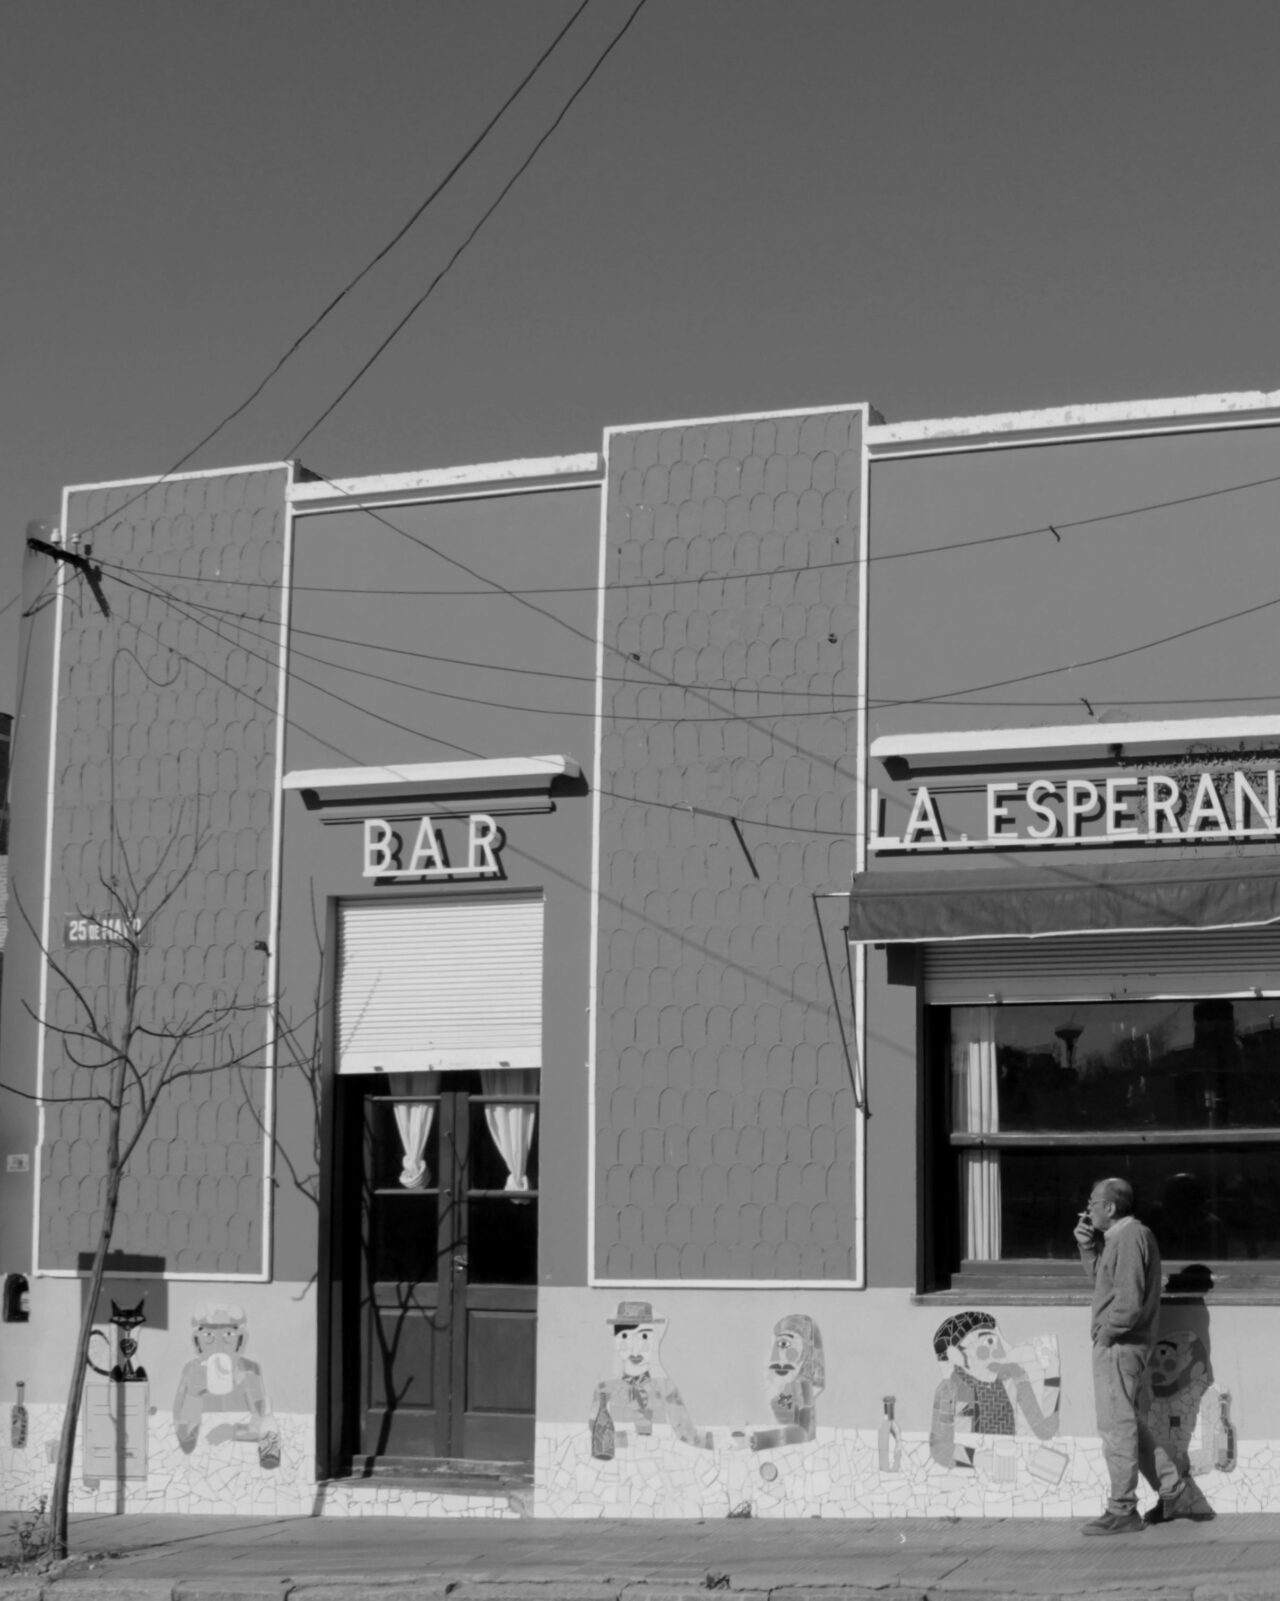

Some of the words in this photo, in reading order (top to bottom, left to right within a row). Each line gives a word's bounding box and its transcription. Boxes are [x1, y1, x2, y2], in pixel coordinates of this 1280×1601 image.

[363, 814, 498, 875] BAR
[69, 920, 88, 941] 25
[89, 924, 101, 940] DE
[102, 918, 142, 940] MAO
